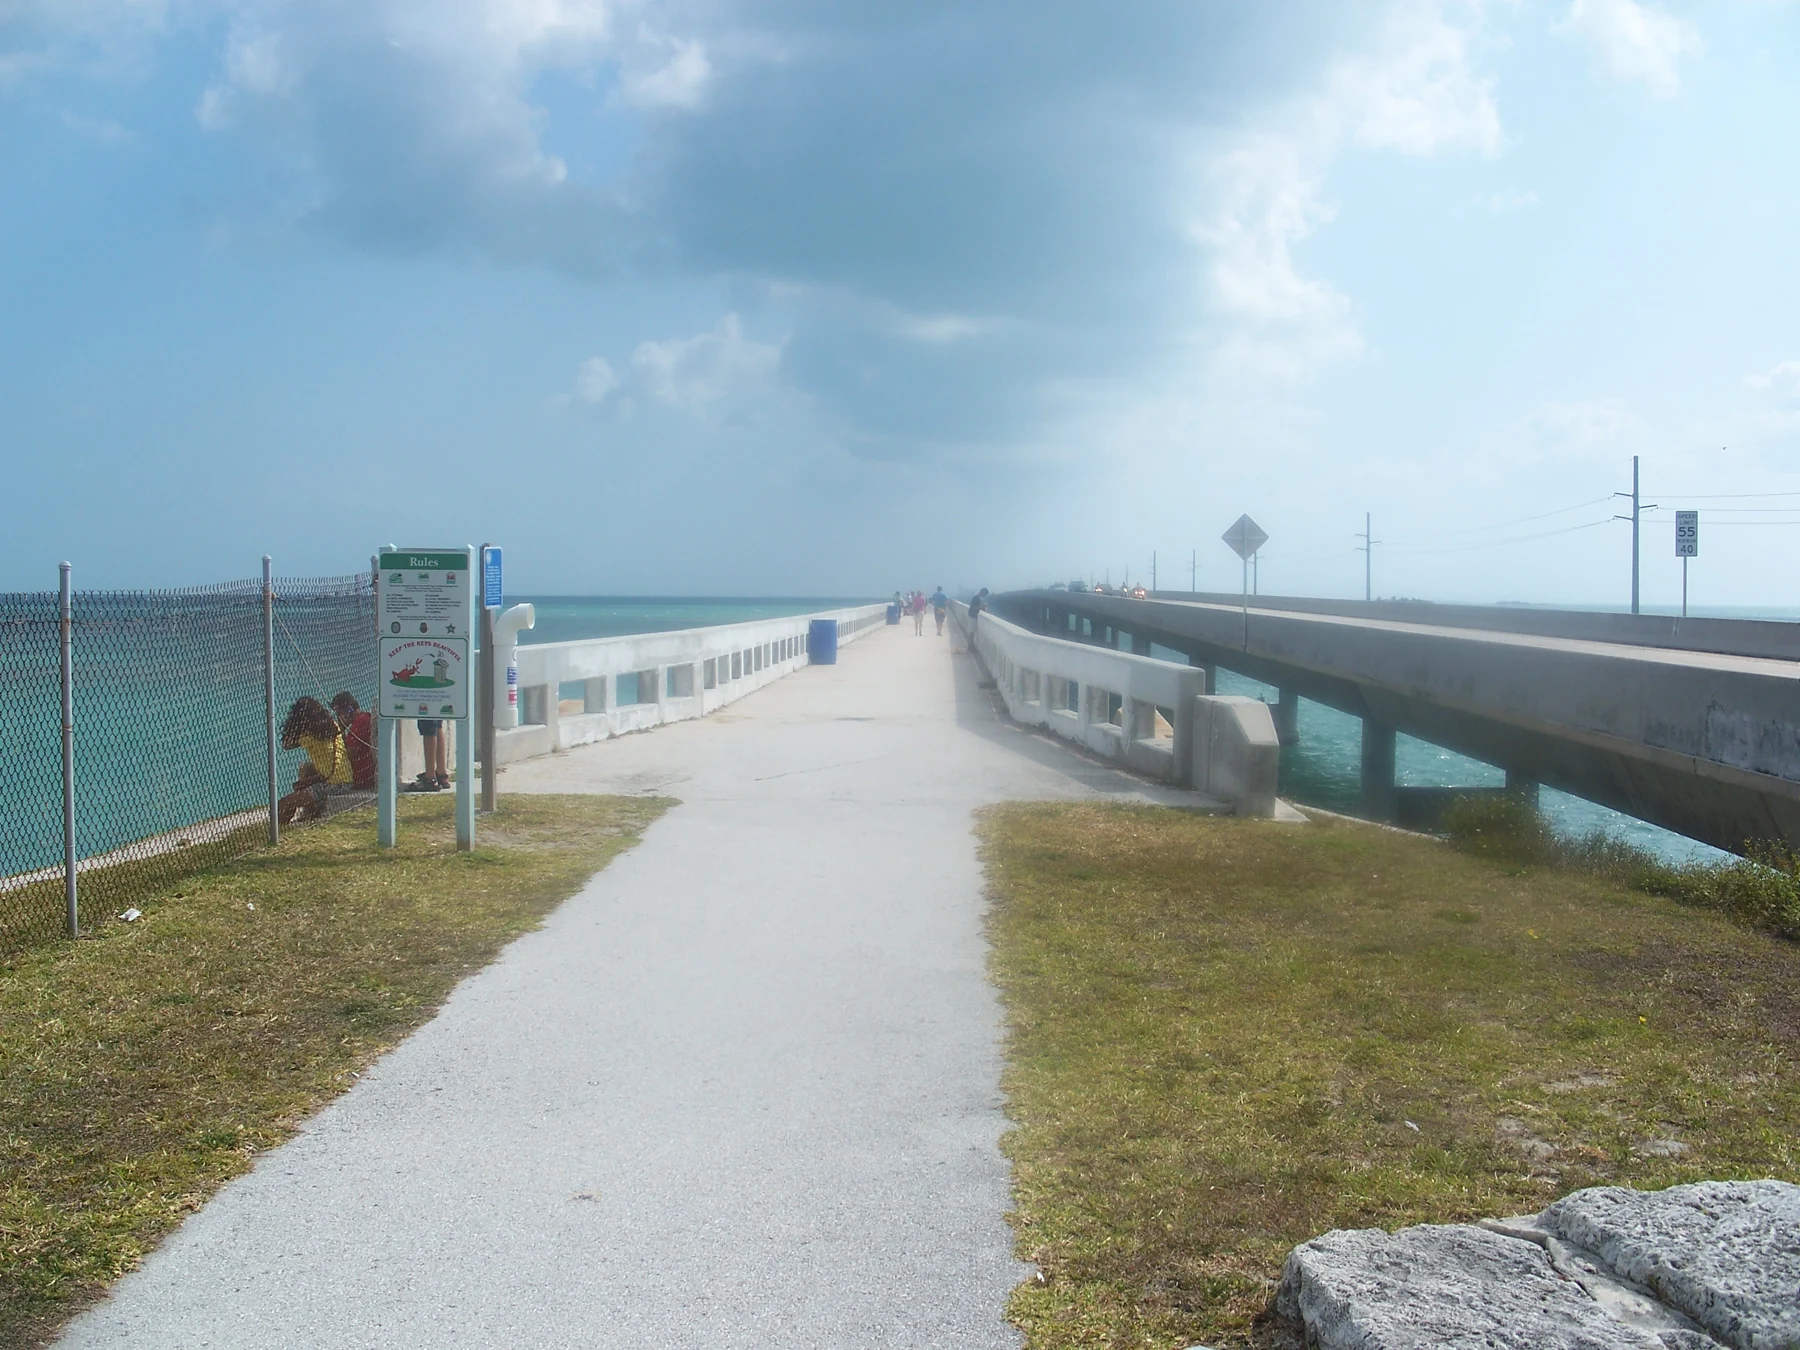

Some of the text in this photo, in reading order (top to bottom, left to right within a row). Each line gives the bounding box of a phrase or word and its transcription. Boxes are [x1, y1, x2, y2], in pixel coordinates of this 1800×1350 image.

[1678, 526, 1695, 537] 55
[1680, 544, 1694, 554] 40
[410, 557, 439, 567] Rules
[388, 645, 402, 658] KEEP
[403, 641, 416, 649] THE
[433, 642, 461, 662] BEAUTIFUL
